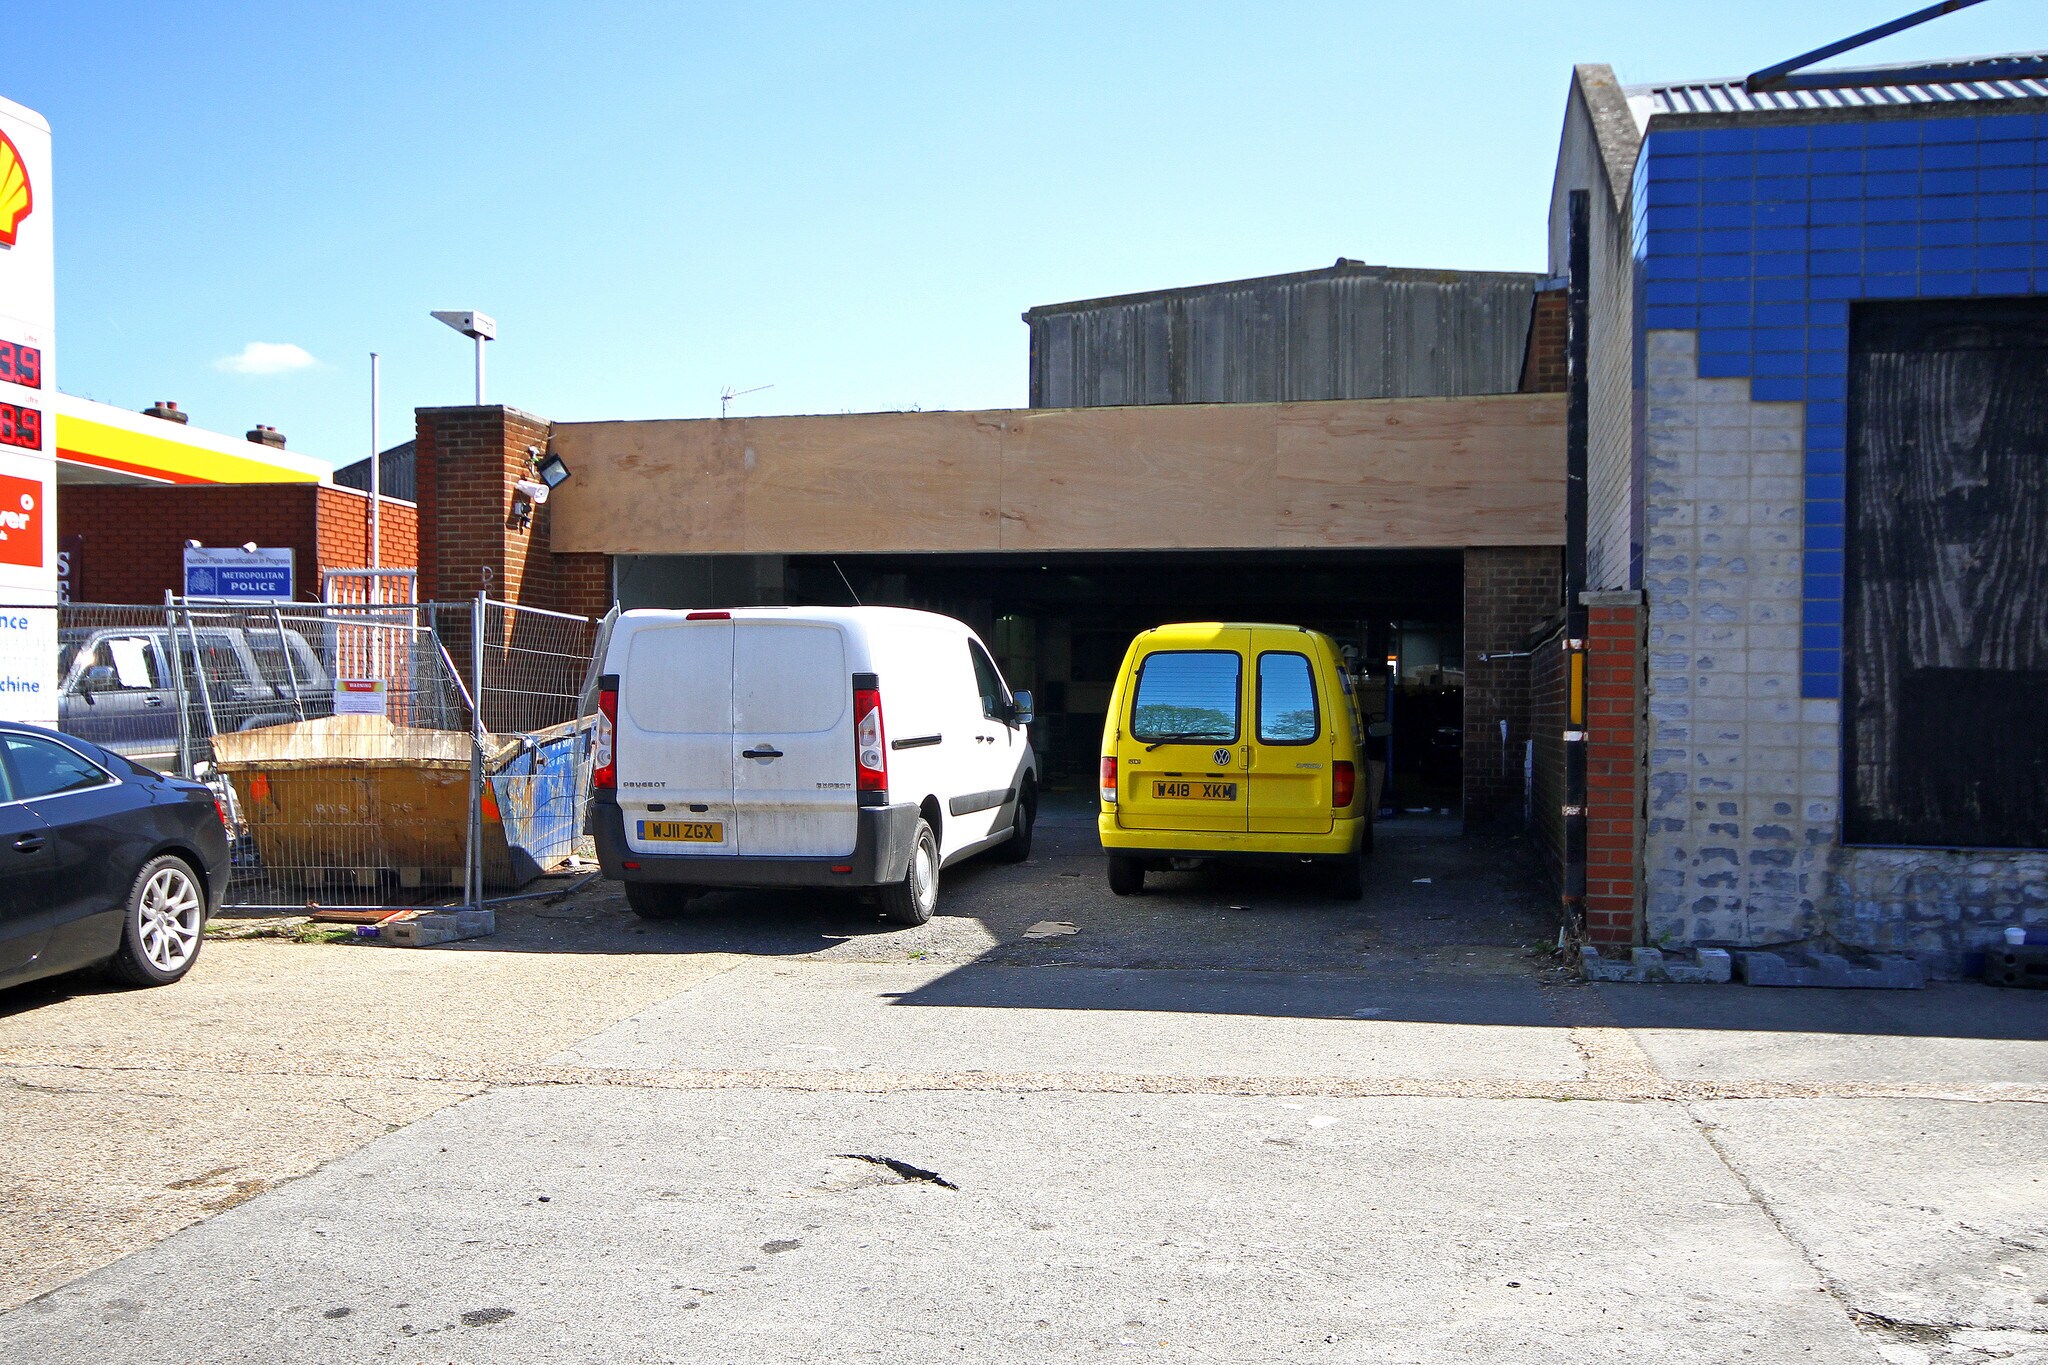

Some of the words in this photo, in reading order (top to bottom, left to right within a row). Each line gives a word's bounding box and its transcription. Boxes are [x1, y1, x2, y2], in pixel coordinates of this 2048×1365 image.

[222, 571, 285, 579] METROPOLITAN
[231, 582, 276, 591] POLICE
[1203, 784, 1231, 798] XKM
[684, 824, 713, 839] ZGX
